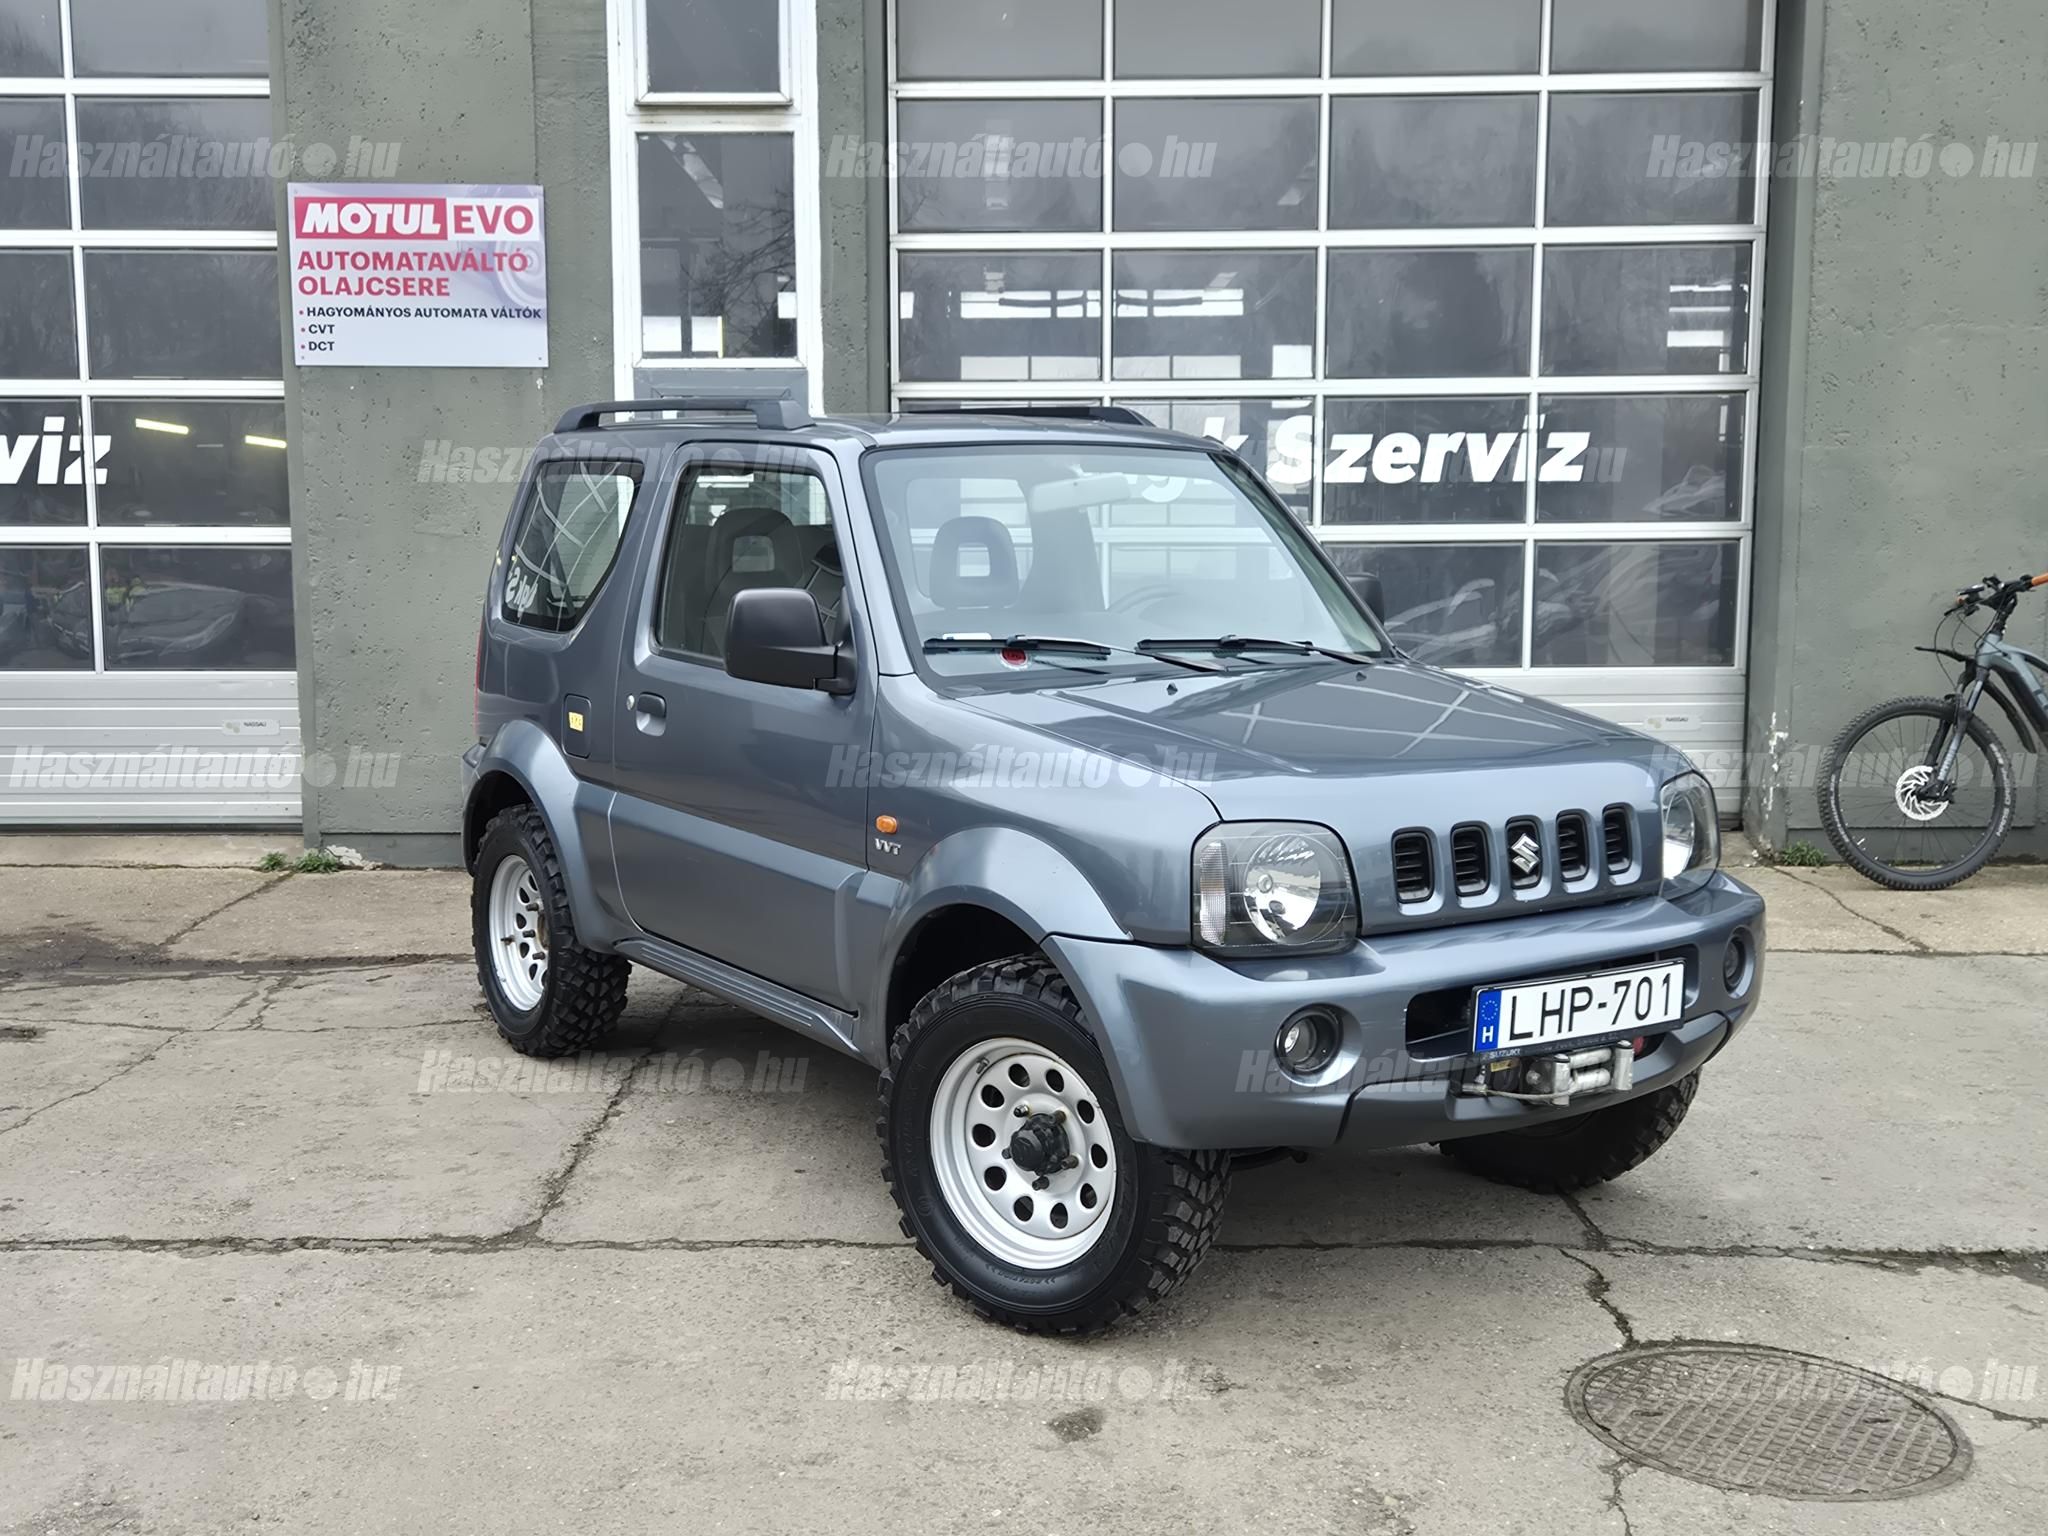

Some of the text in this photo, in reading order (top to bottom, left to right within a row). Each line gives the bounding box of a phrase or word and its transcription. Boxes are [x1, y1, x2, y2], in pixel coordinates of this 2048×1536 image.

[301, 202, 534, 235] MOTUL EVO
[297, 248, 528, 272] AUTOMATAVÁLTÓ
[298, 276, 450, 297] OLAJCSERE
[307, 306, 542, 319] HAGYOMÁNYOS AUTOMATA VÁLTÓK
[308, 324, 335, 334] CVT
[308, 341, 335, 351] DCT
[1266, 413, 1590, 485] Szerviz
[875, 838, 901, 855] VVT
[1508, 973, 1672, 1041] LHP-701
[1482, 1026, 1494, 1043] H
